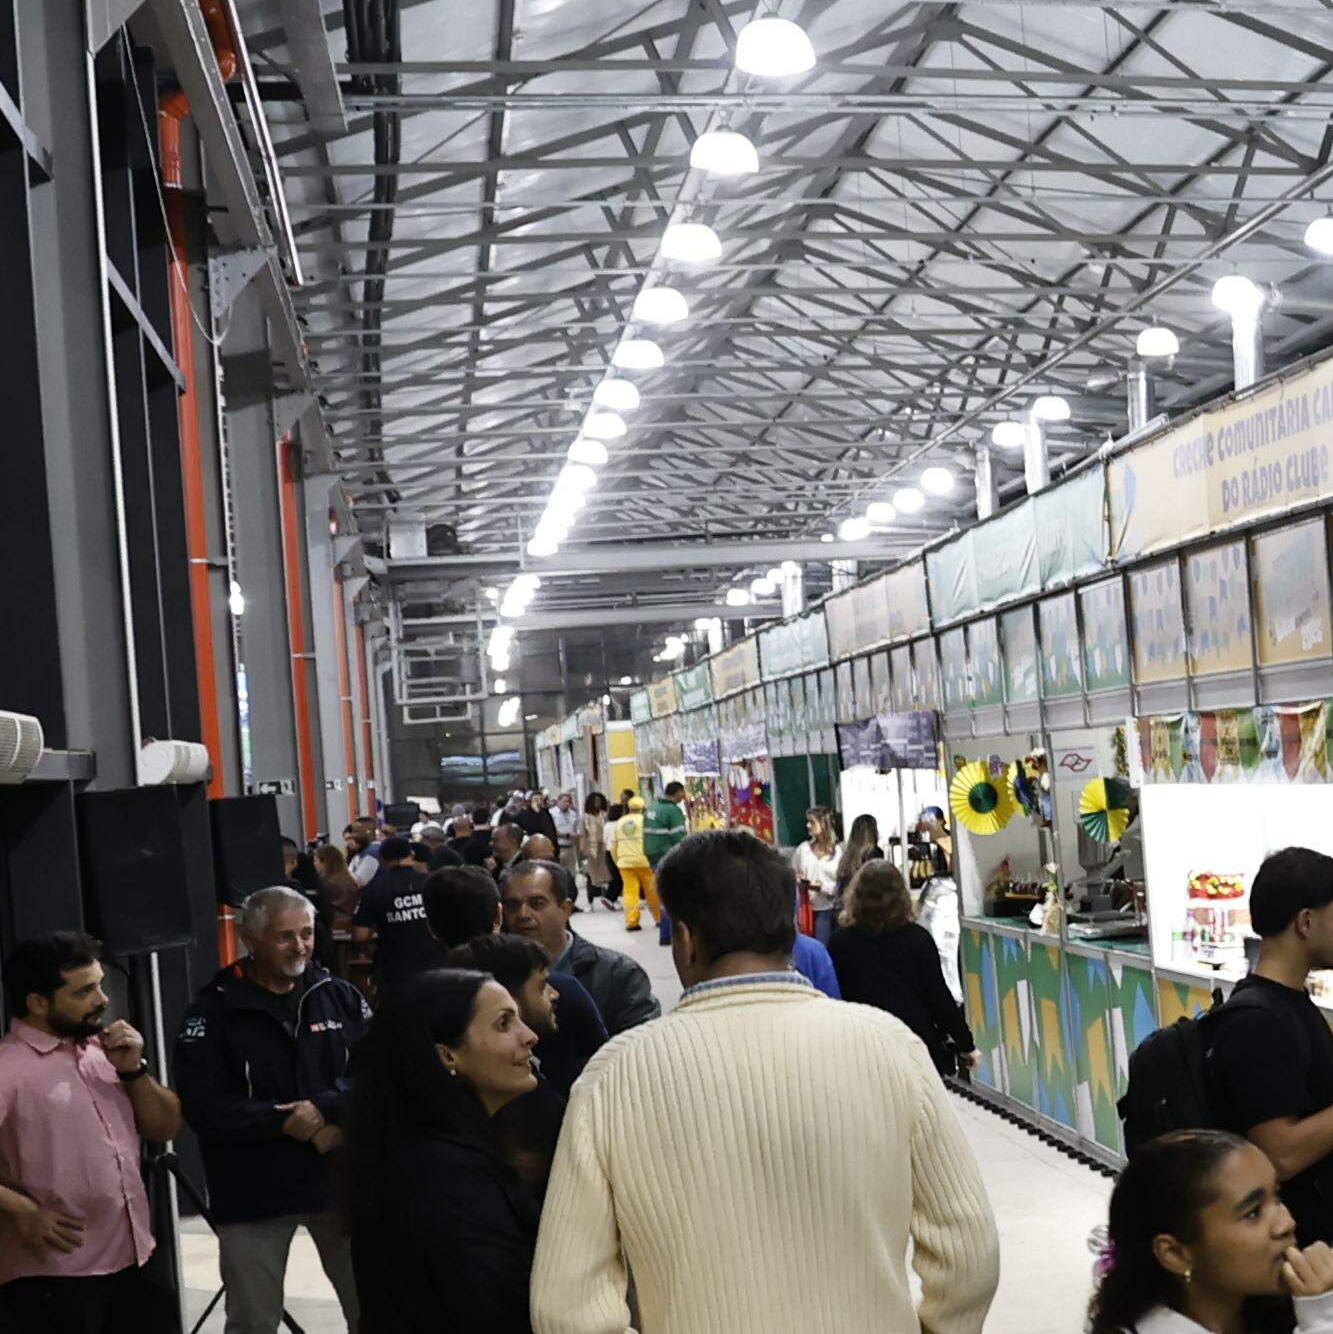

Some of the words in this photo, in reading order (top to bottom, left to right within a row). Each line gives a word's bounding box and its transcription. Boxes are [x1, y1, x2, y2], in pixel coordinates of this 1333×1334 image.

[1221, 478, 1239, 513] DO
[1243, 457, 1283, 509] RÁDIO
[394, 893, 423, 909] GCM
[386, 906, 428, 923] SANTO
